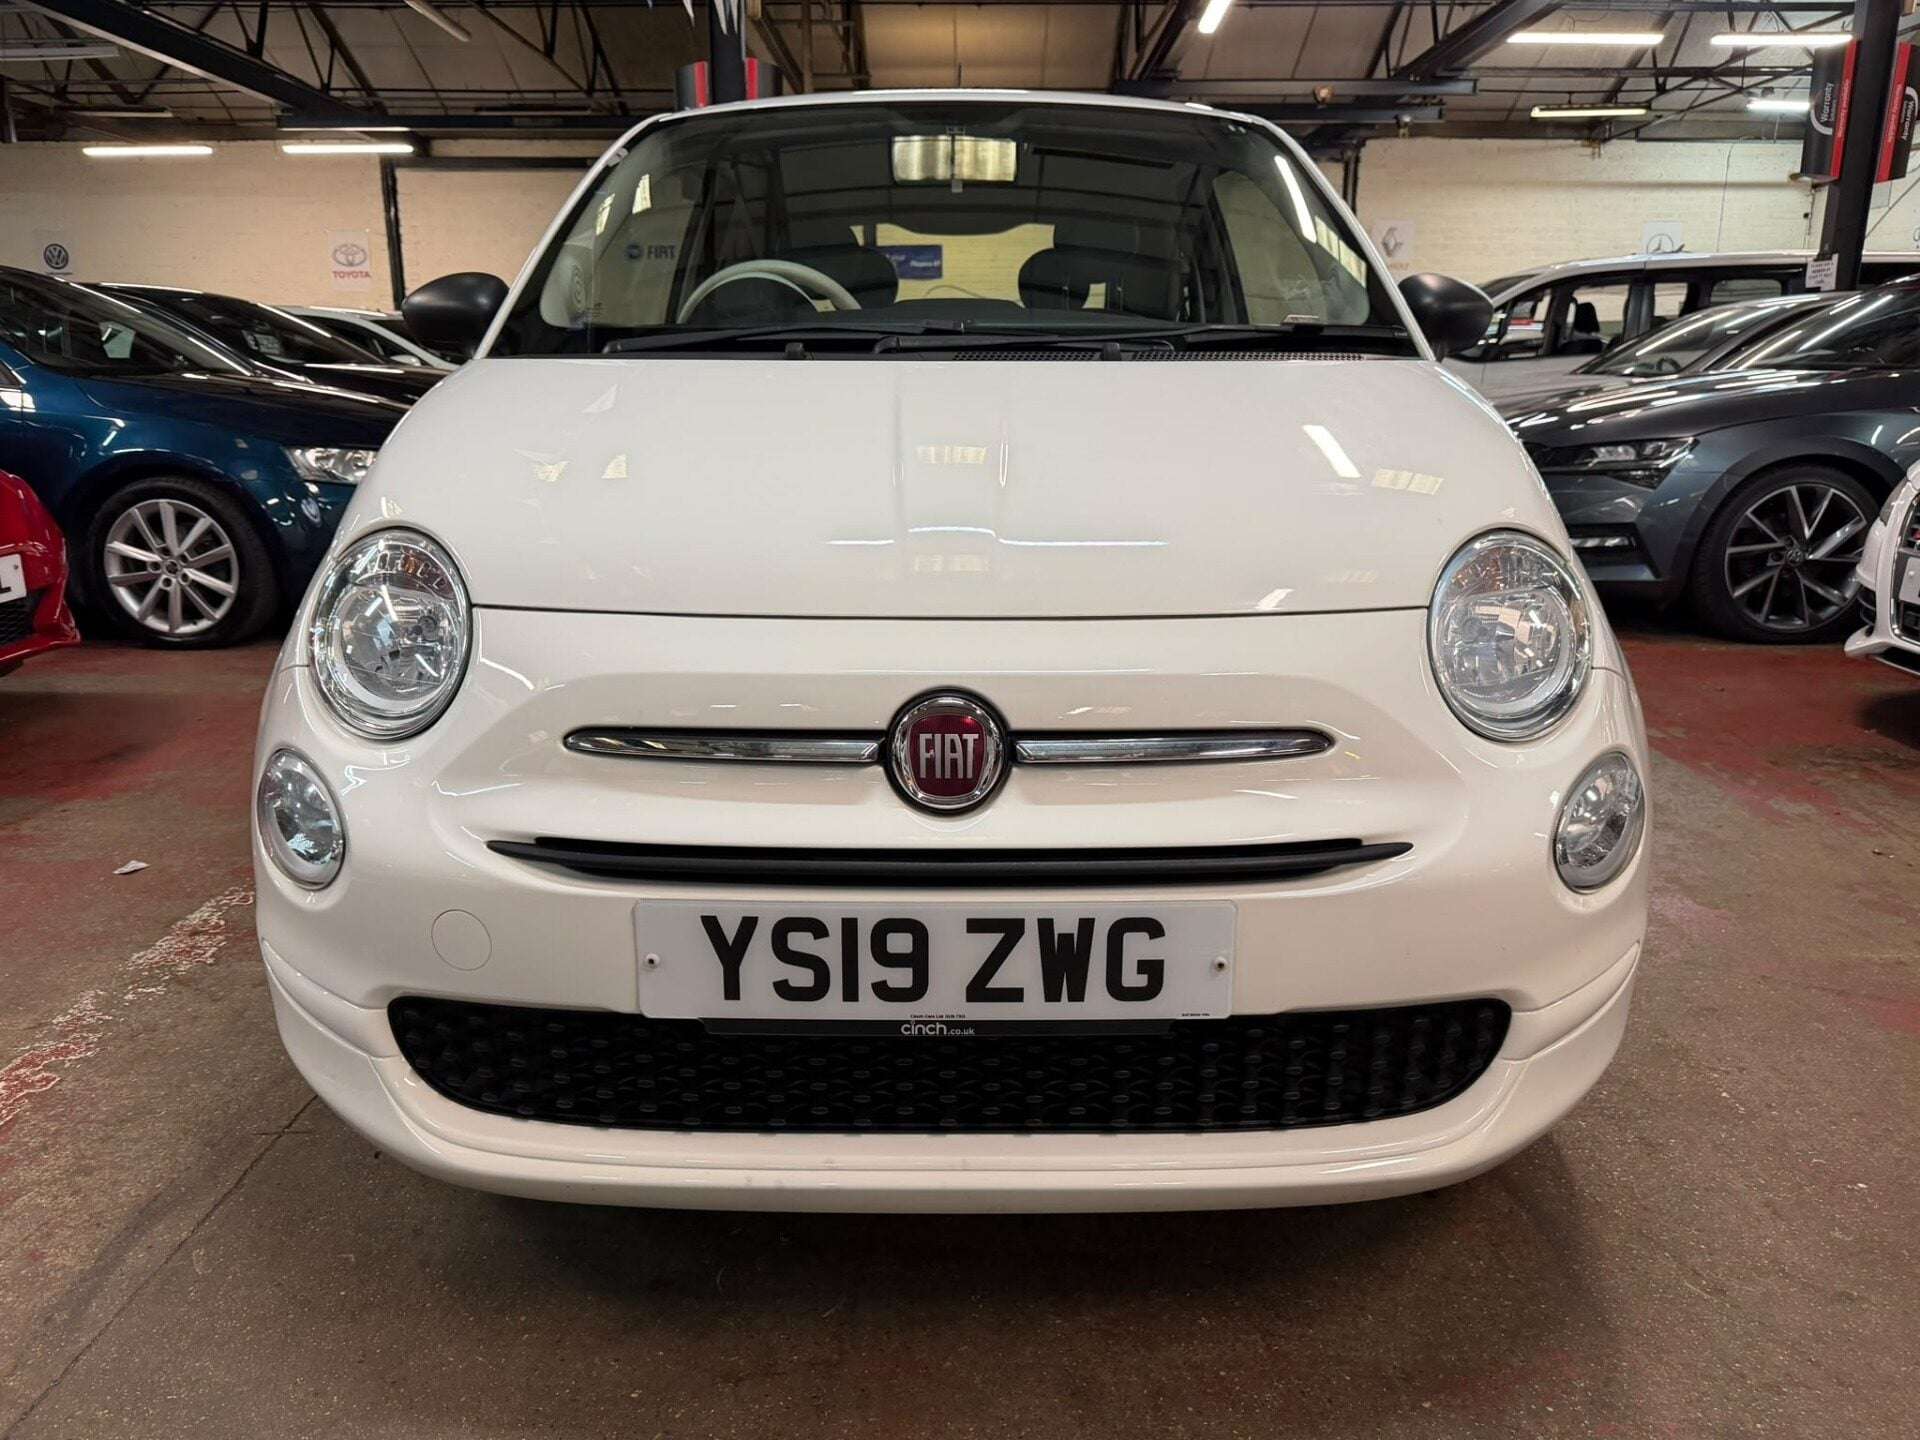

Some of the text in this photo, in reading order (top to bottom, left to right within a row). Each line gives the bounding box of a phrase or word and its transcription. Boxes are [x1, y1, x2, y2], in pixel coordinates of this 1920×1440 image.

[1820, 82, 1835, 122] Warranty
[1900, 101, 1914, 140] Warranty
[647, 244, 676, 259] FIAT
[332, 270, 371, 279] TOYOTA
[919, 733, 979, 779] FIAT
[700, 915, 1166, 1003] YS19 ZWG
[900, 1020, 976, 1036] cinch.co.uk
